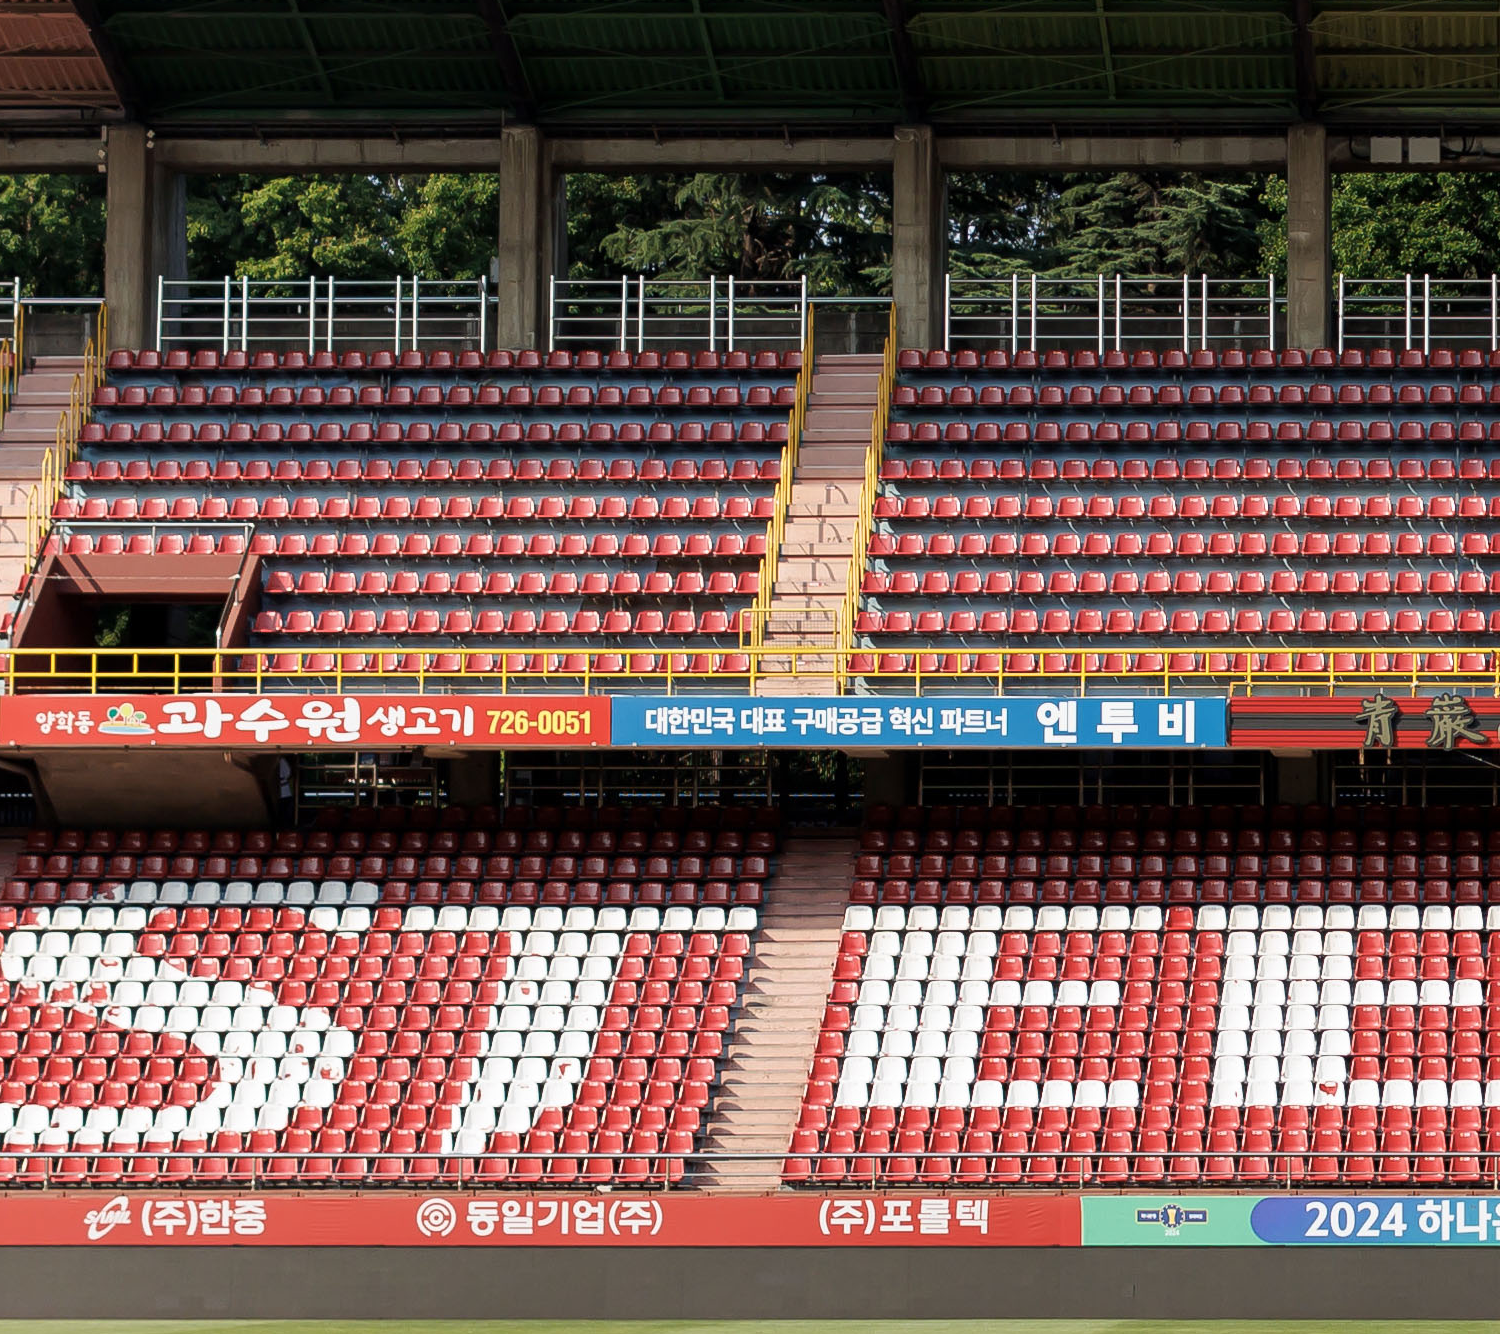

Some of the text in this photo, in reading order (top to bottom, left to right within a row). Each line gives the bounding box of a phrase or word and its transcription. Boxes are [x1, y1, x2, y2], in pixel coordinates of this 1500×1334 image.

[35, 711, 95, 735] 양학동
[157, 697, 592, 743] 과수원 생고기 726-0051
[645, 706, 1008, 737] 대한민국 대표 구매공급 혁신 파트너
[1036, 700, 1195, 744] 엔투비
[141, 1199, 267, 1236] (주)한중
[466, 1199, 664, 1236] 동일기업(주)
[1304, 1200, 1407, 1238] 2024
